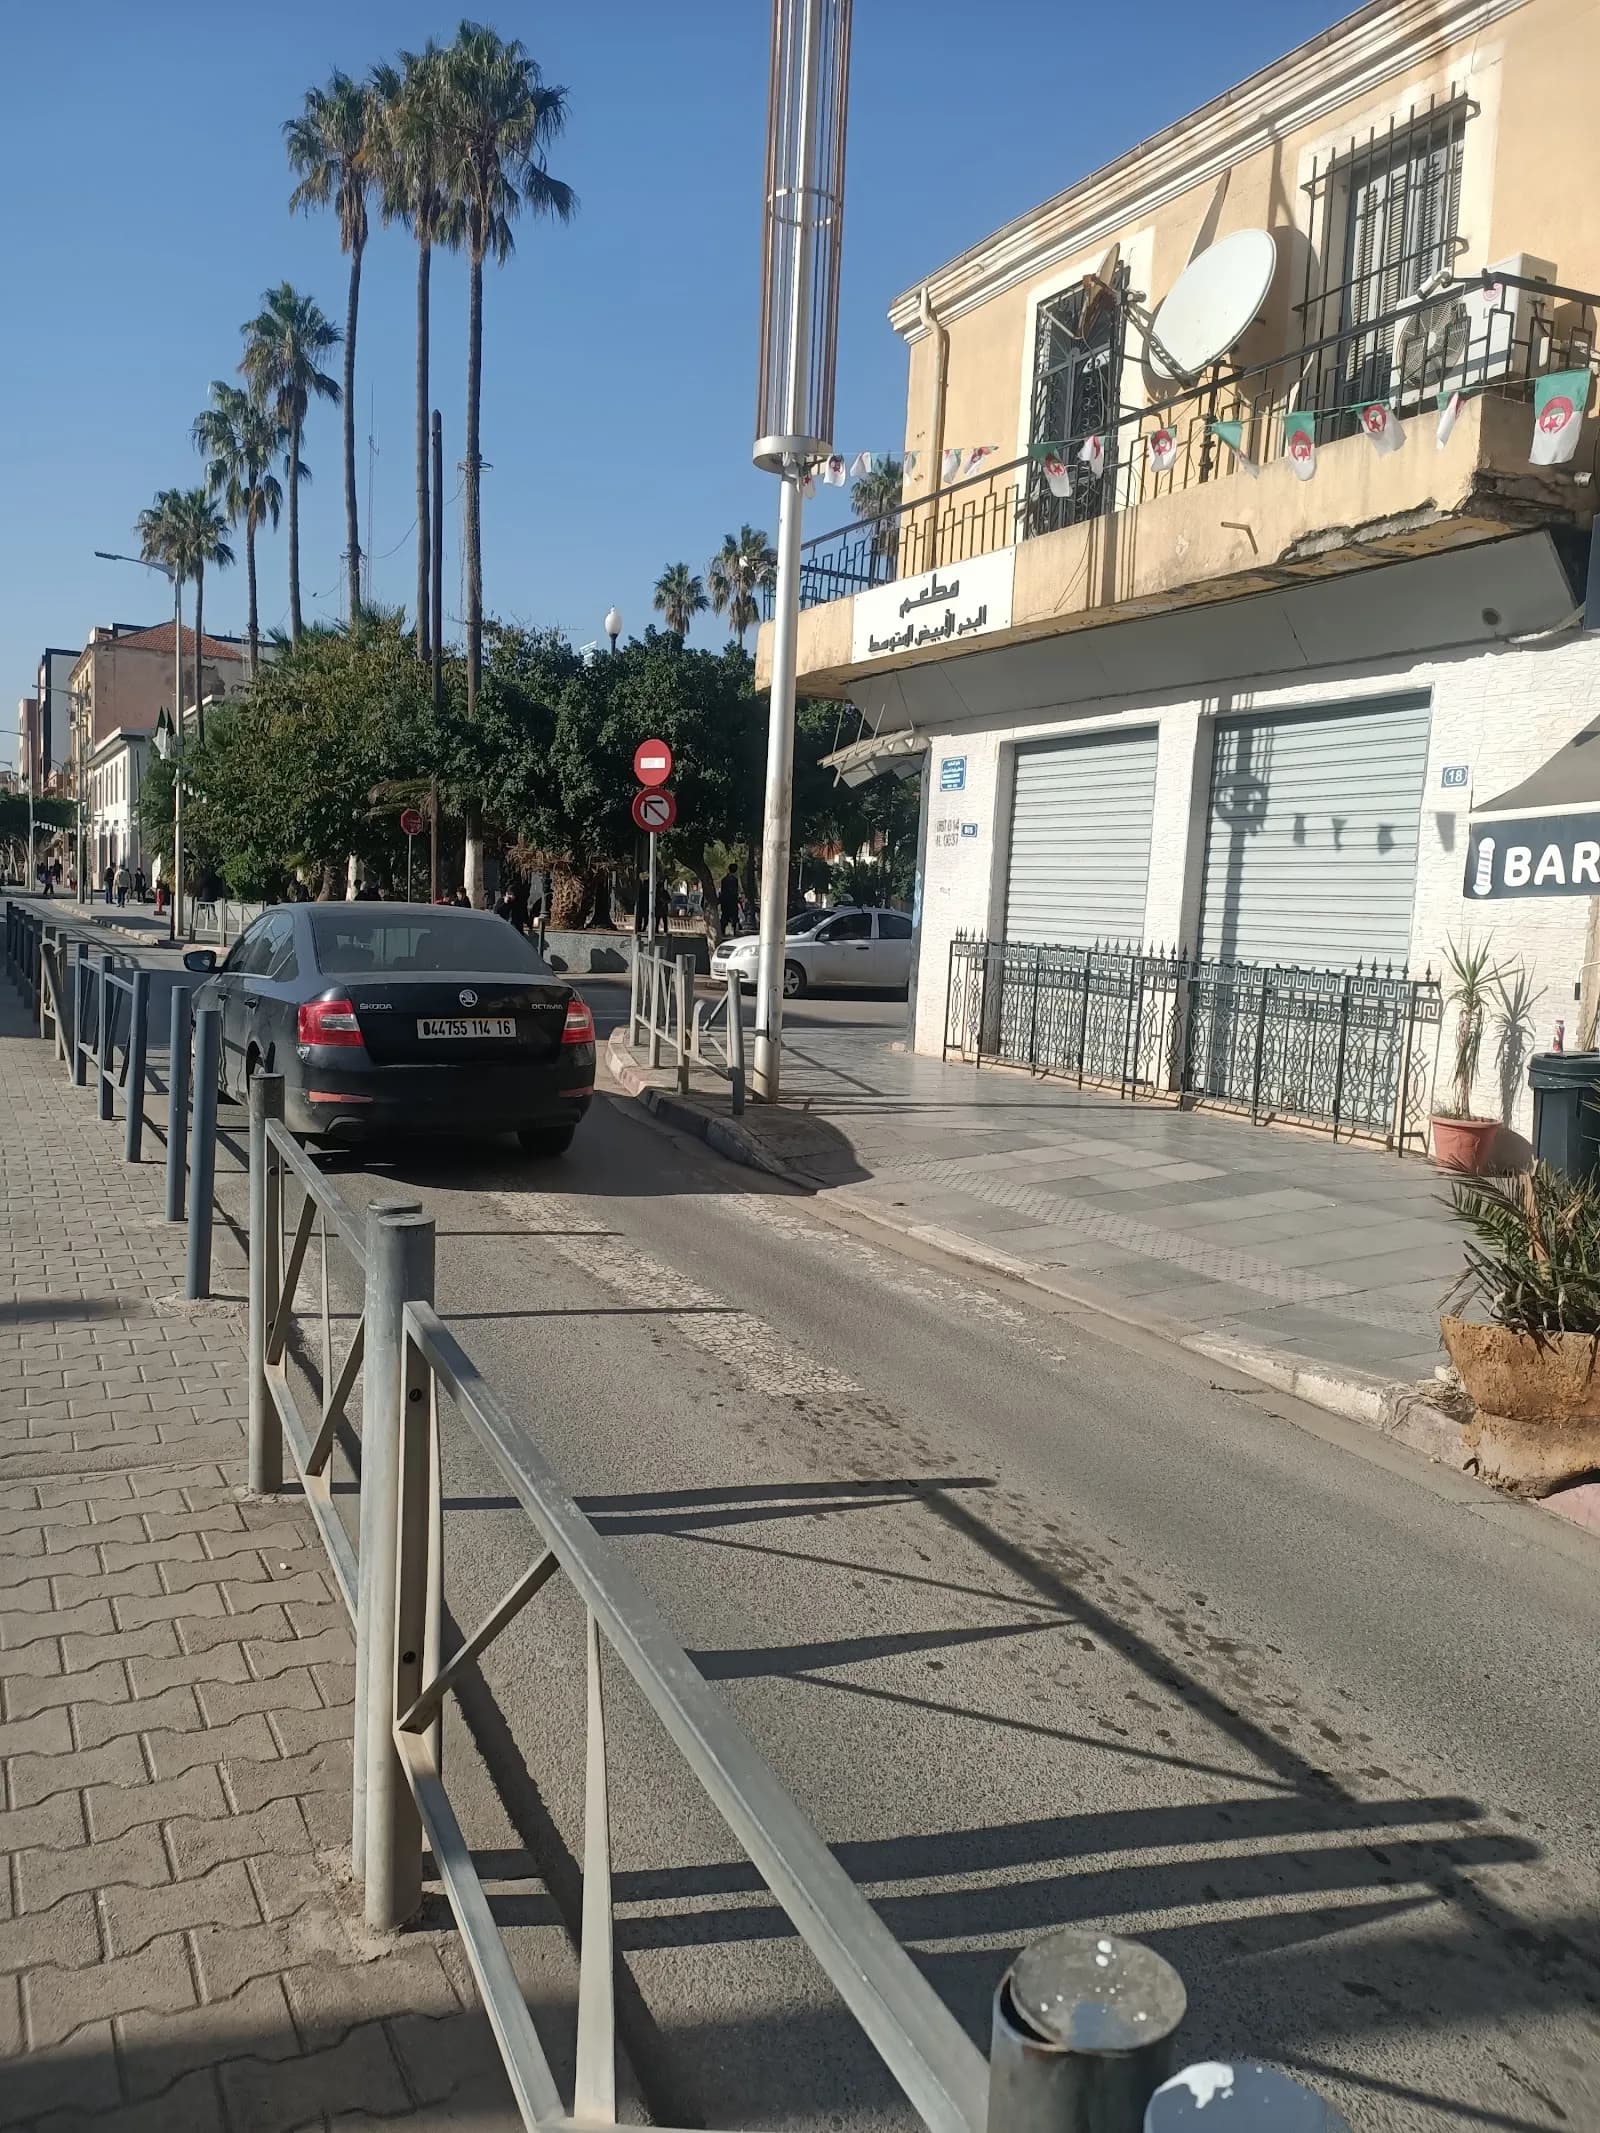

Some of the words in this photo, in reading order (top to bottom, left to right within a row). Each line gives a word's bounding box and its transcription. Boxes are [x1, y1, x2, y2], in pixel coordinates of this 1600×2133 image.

[899, 573, 959, 619] مطعم
[915, 609, 956, 645] الأبيض
[957, 605, 987, 636] البحر
[868, 624, 914, 652] المتوسط
[1448, 770, 1463, 783] 18
[1503, 841, 1600, 887] BAR
[423, 1020, 468, 1035] 044755
[472, 1020, 491, 1035] 114
[497, 1020, 511, 1035] 16
